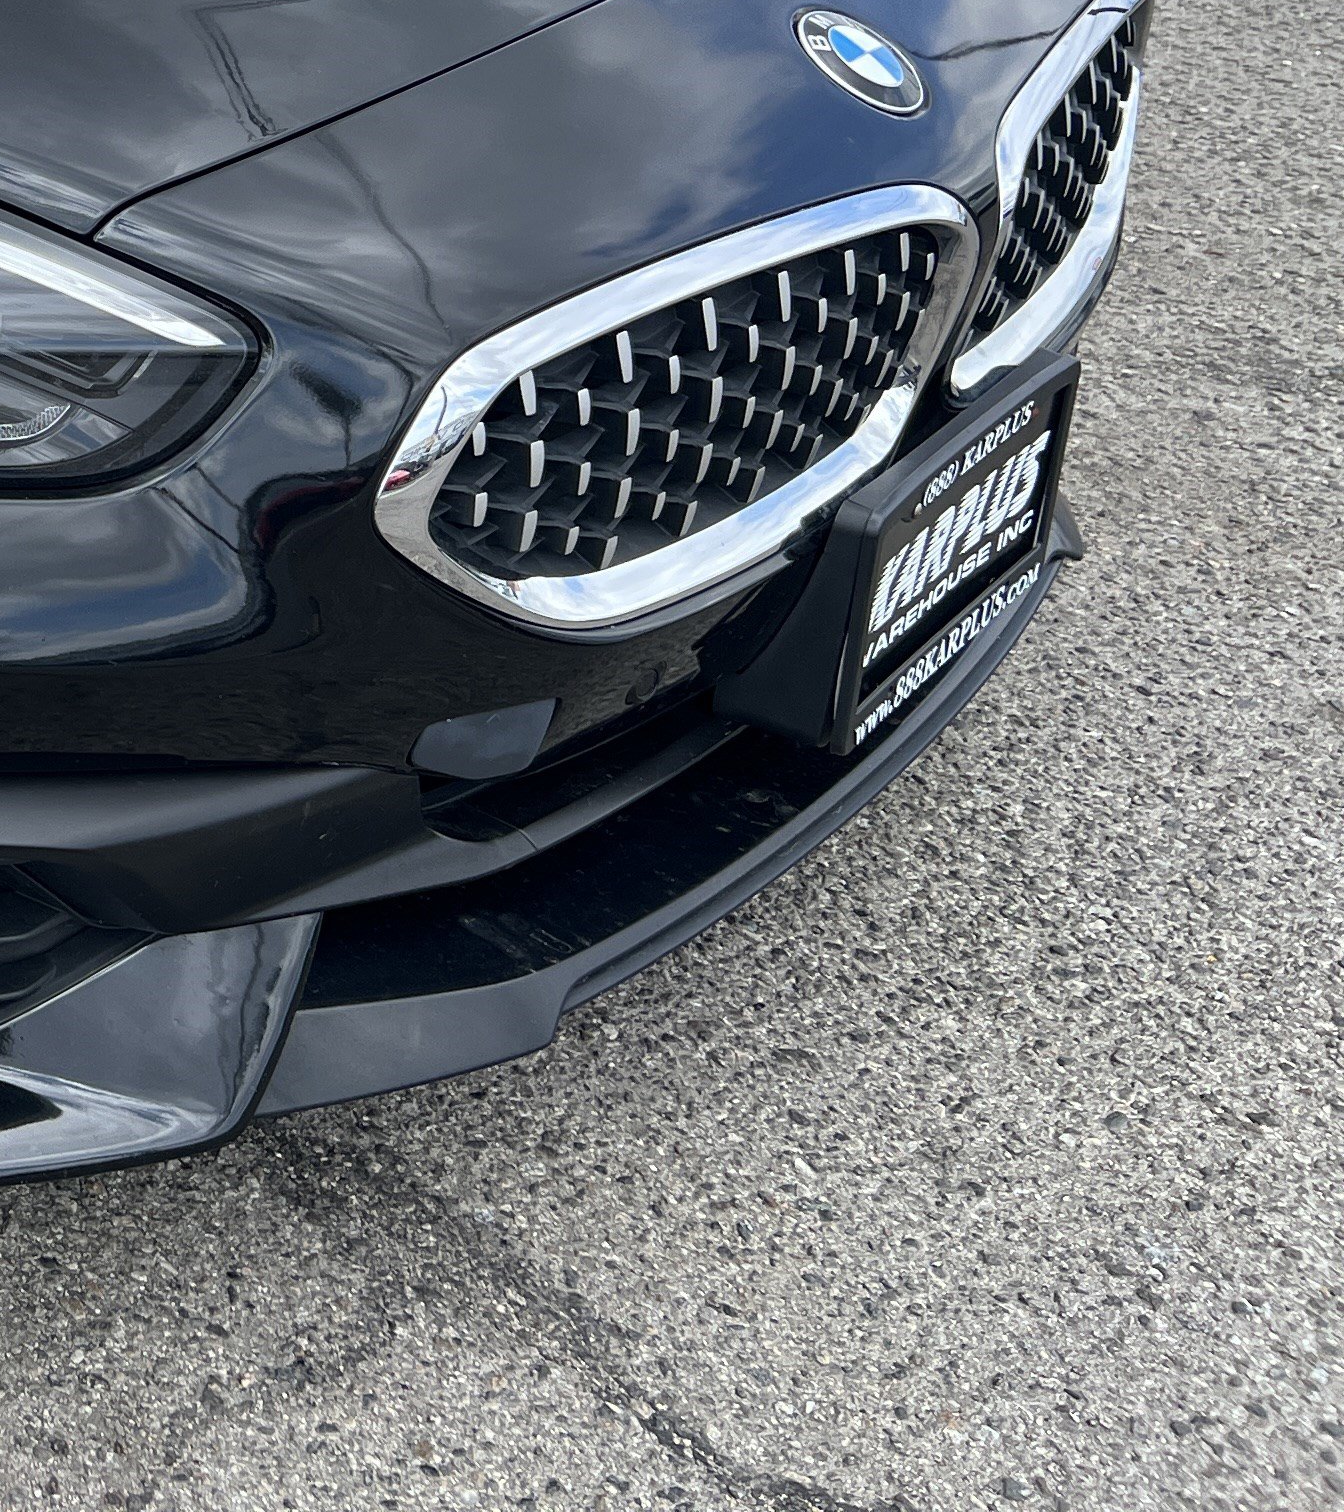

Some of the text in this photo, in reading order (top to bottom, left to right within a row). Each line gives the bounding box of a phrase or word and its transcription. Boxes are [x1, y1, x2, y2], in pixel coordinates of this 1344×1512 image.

[923, 400, 1035, 507] (888) KARPLUS
[996, 509, 1034, 552] INC
